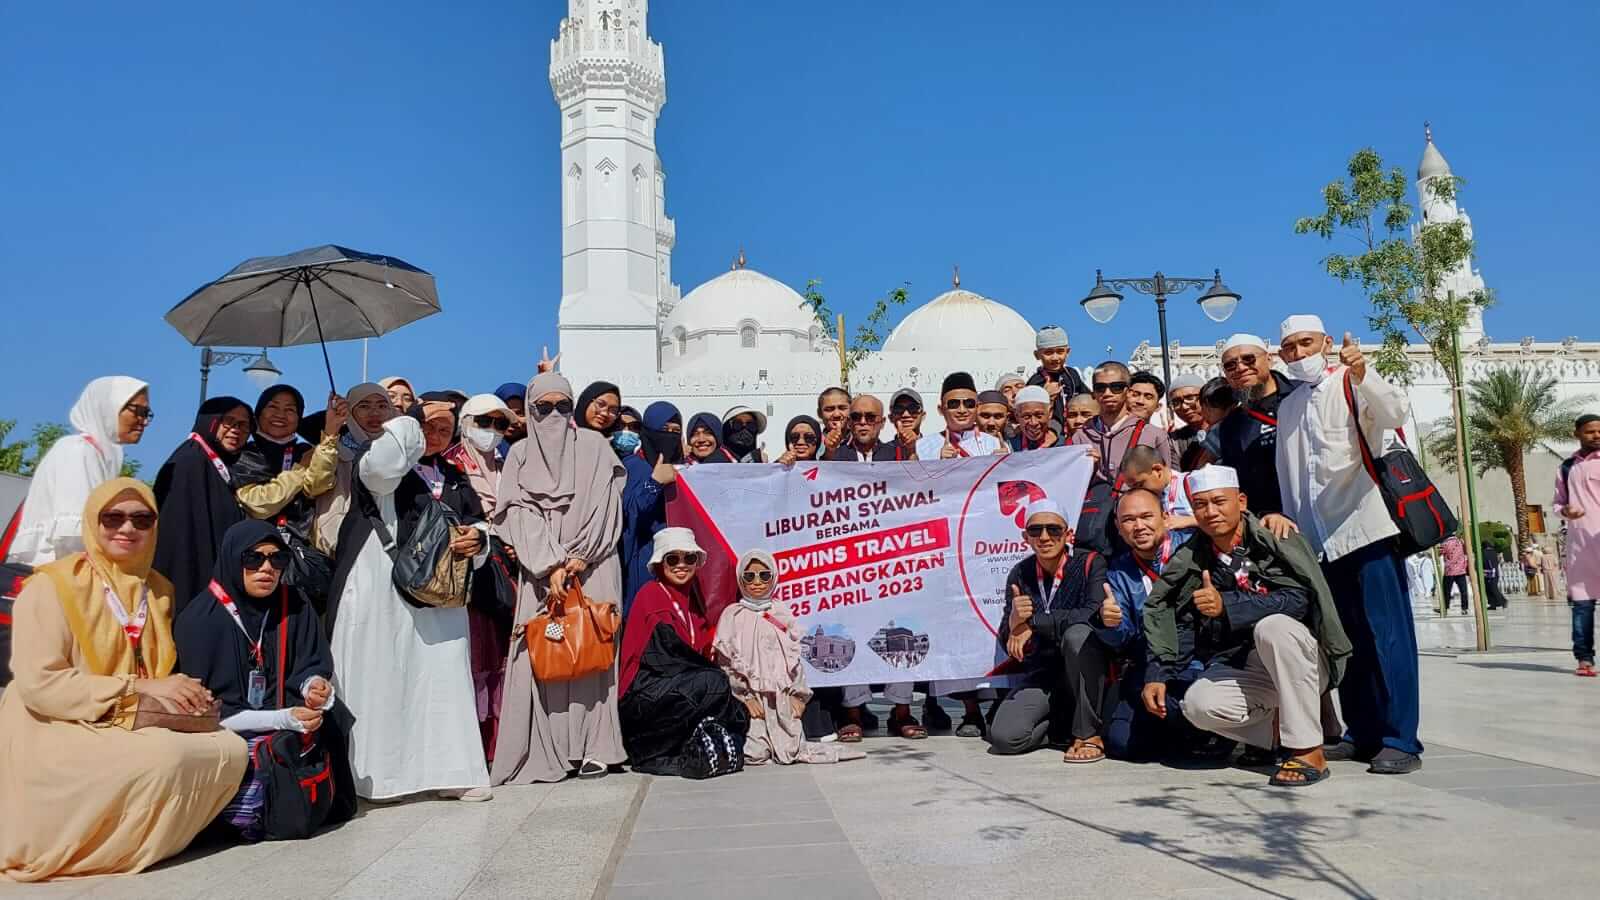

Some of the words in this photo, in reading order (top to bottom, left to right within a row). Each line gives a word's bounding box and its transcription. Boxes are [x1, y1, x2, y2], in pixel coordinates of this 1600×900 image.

[765, 506, 850, 538] LIBURAN
[858, 490, 940, 518] SYAWAL
[810, 480, 887, 508] UMROH
[816, 518, 880, 540] BERSAMA
[975, 539, 1028, 555] Dwins
[778, 545, 847, 575] DWINS
[854, 528, 936, 559] TRAVEL
[771, 552, 945, 601] KEBERANGKATAN
[790, 600, 811, 617] 25
[817, 588, 872, 612] APRIL
[878, 576, 923, 599] 2023
